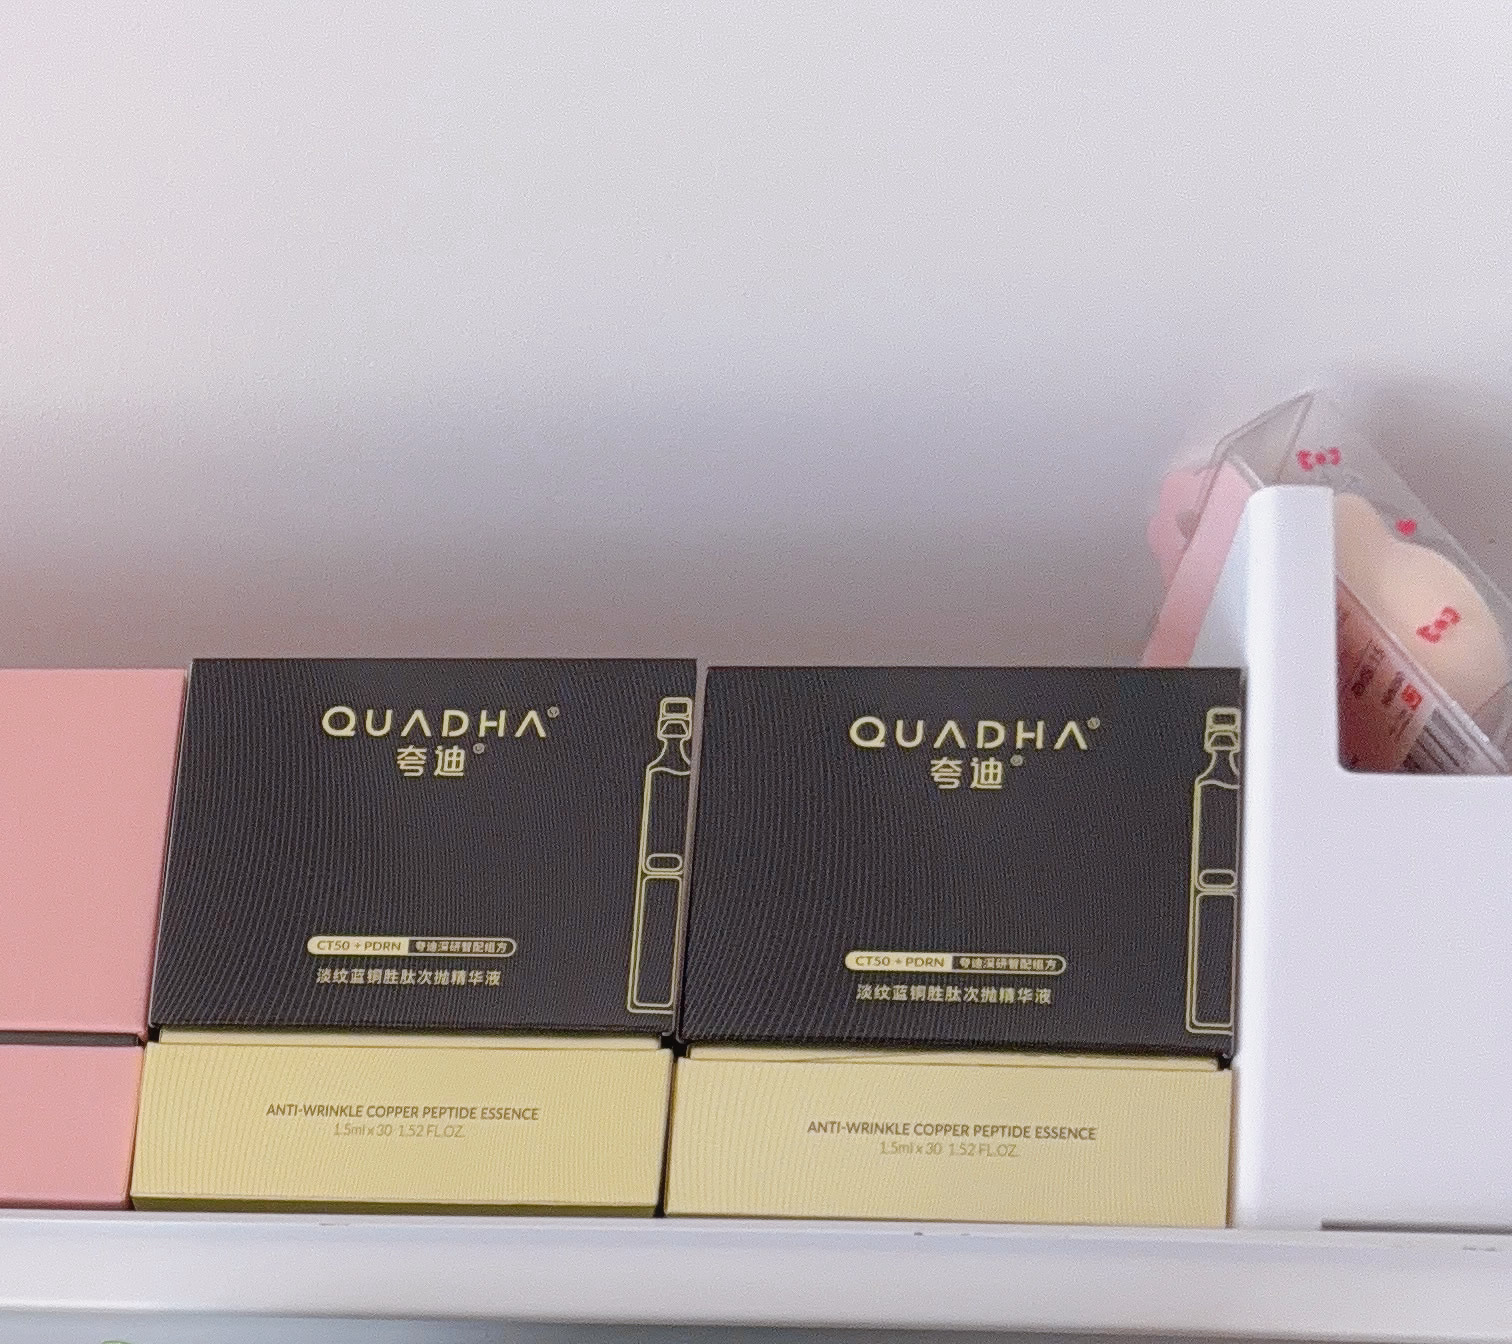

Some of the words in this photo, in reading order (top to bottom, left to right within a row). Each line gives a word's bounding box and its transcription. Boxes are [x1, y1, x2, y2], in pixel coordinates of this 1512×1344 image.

[322, 706, 546, 738] QUADHA
[849, 716, 1088, 749] QUADHA
[396, 745, 465, 777] 夸迪
[930, 757, 1003, 789] 夸迪
[317, 940, 350, 951] CT50
[365, 941, 401, 952] PDRN
[855, 956, 890, 967] CT50
[906, 957, 945, 968] PDRN
[316, 968, 502, 986] 淡纹蓝铜胜肽次抛精华液
[856, 984, 1052, 1004] 淡纹蓝铜胜肽次抛精华液
[266, 1104, 363, 1118] ANTI-WRINKLE
[366, 1105, 419, 1119] COPPER
[422, 1106, 477, 1120] PEPTIDE
[480, 1107, 538, 1121] ESSENCE
[377, 1123, 392, 1137] 30
[807, 1121, 910, 1136] ANTI-WRINKLE
[913, 1122, 969, 1137] COPPER
[973, 1124, 1031, 1139] PEPTIDE
[1034, 1126, 1097, 1141] ESSENCE
[925, 1142, 942, 1156] 30
